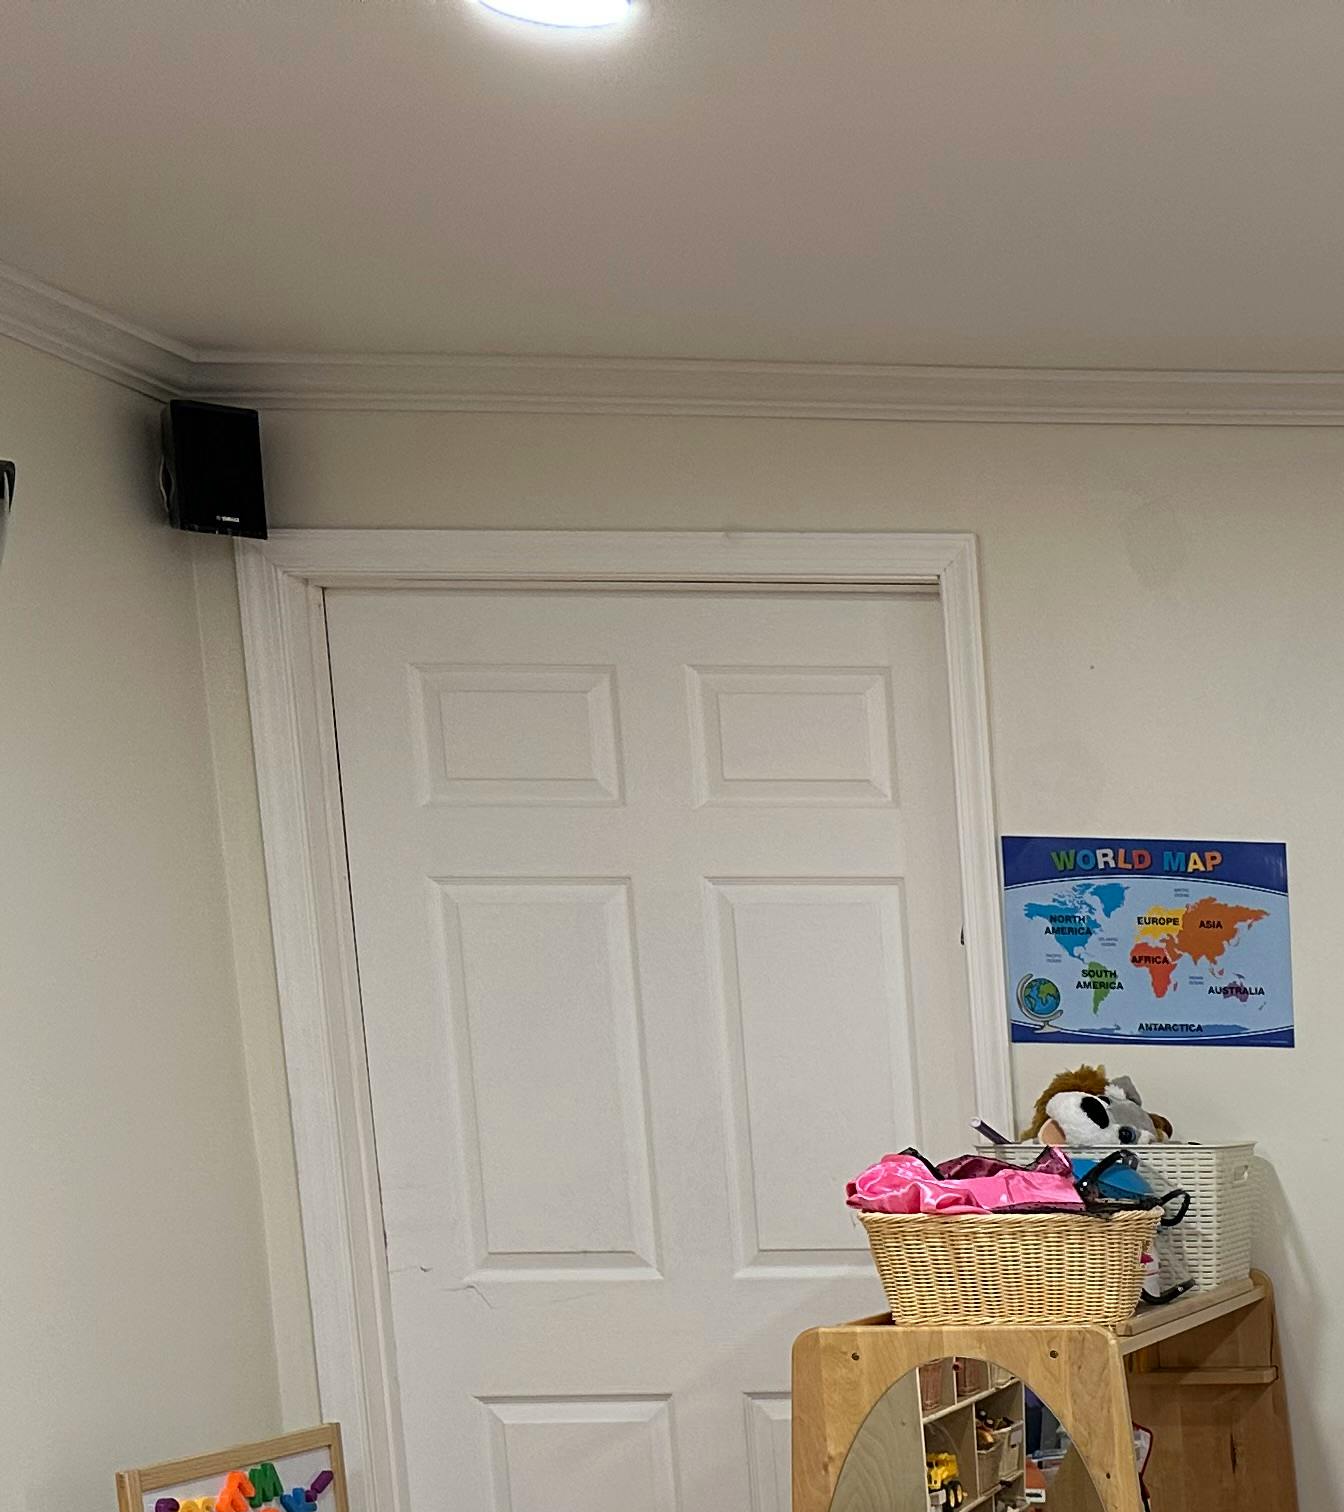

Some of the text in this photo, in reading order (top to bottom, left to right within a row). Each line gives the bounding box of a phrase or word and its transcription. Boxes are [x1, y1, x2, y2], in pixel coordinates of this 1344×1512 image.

[1051, 849, 1223, 873] WORLD MAP
[1050, 915, 1085, 924] NORTH
[1137, 917, 1180, 926] EUROPE
[1199, 920, 1223, 929] ASIA
[1045, 926, 1092, 935] AMERICA
[1131, 956, 1170, 964] AFRICA
[1081, 969, 1117, 978] SOUTH
[1076, 981, 1124, 990] AMERICA
[1208, 986, 1265, 995] AUSTRALIA
[1138, 1023, 1203, 1032] ANTARCTICA
